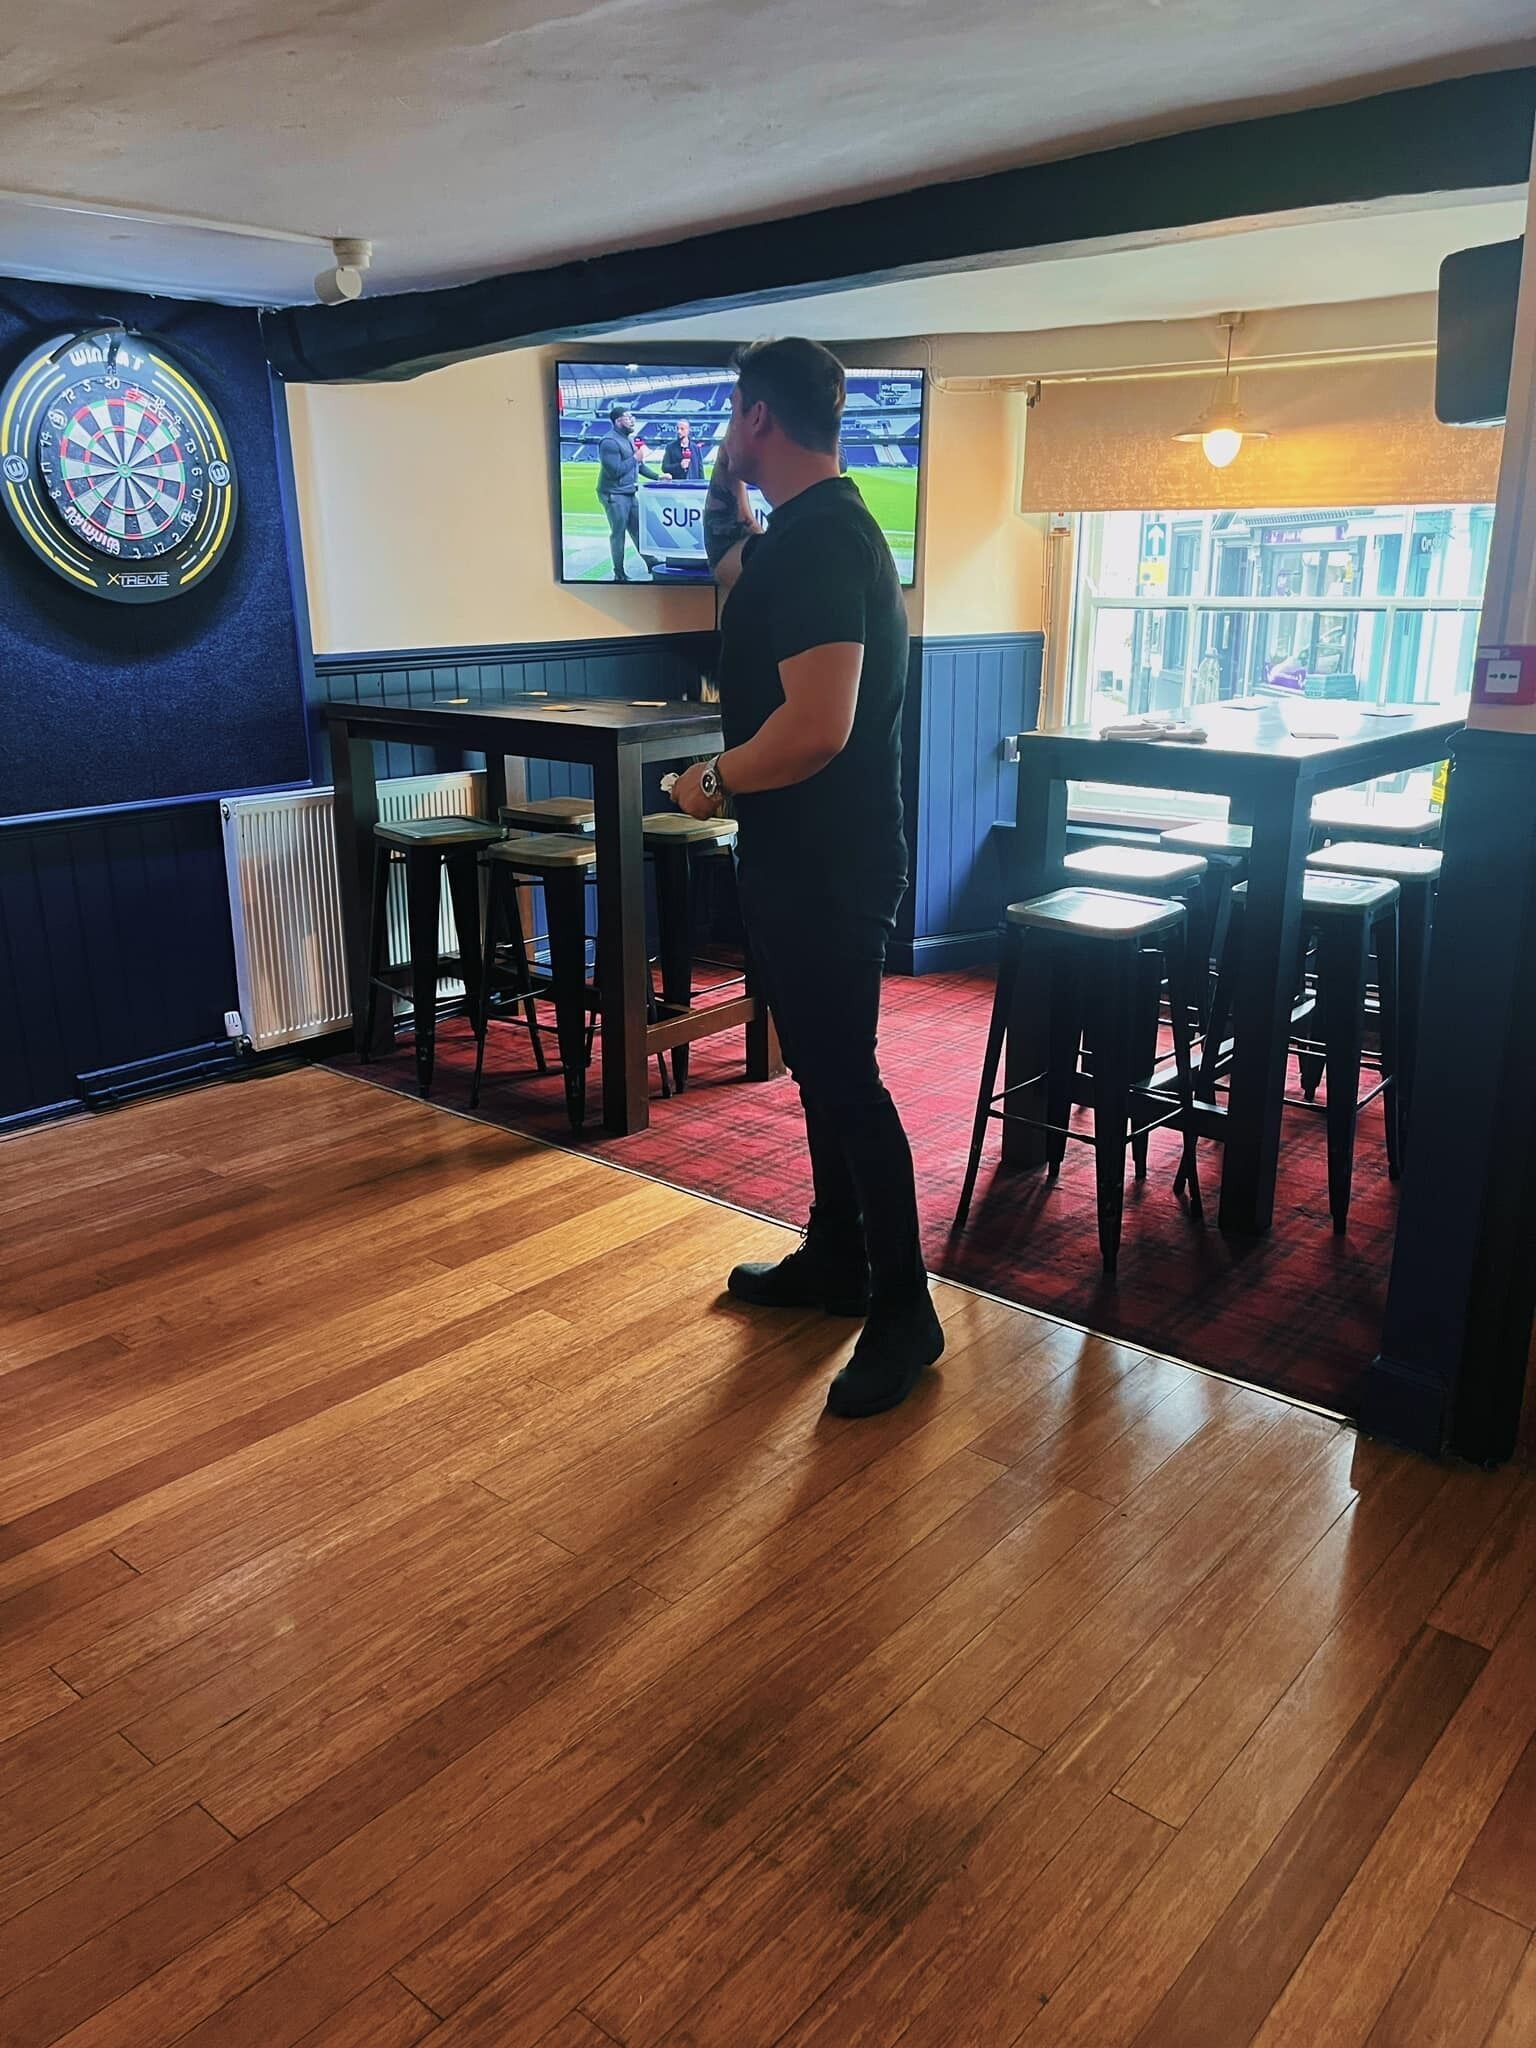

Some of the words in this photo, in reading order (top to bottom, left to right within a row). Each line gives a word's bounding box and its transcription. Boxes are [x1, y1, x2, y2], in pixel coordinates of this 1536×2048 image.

[104, 377, 120, 389] 20
[662, 507, 701, 528] SUP
[107, 573, 169, 586] XTREME
